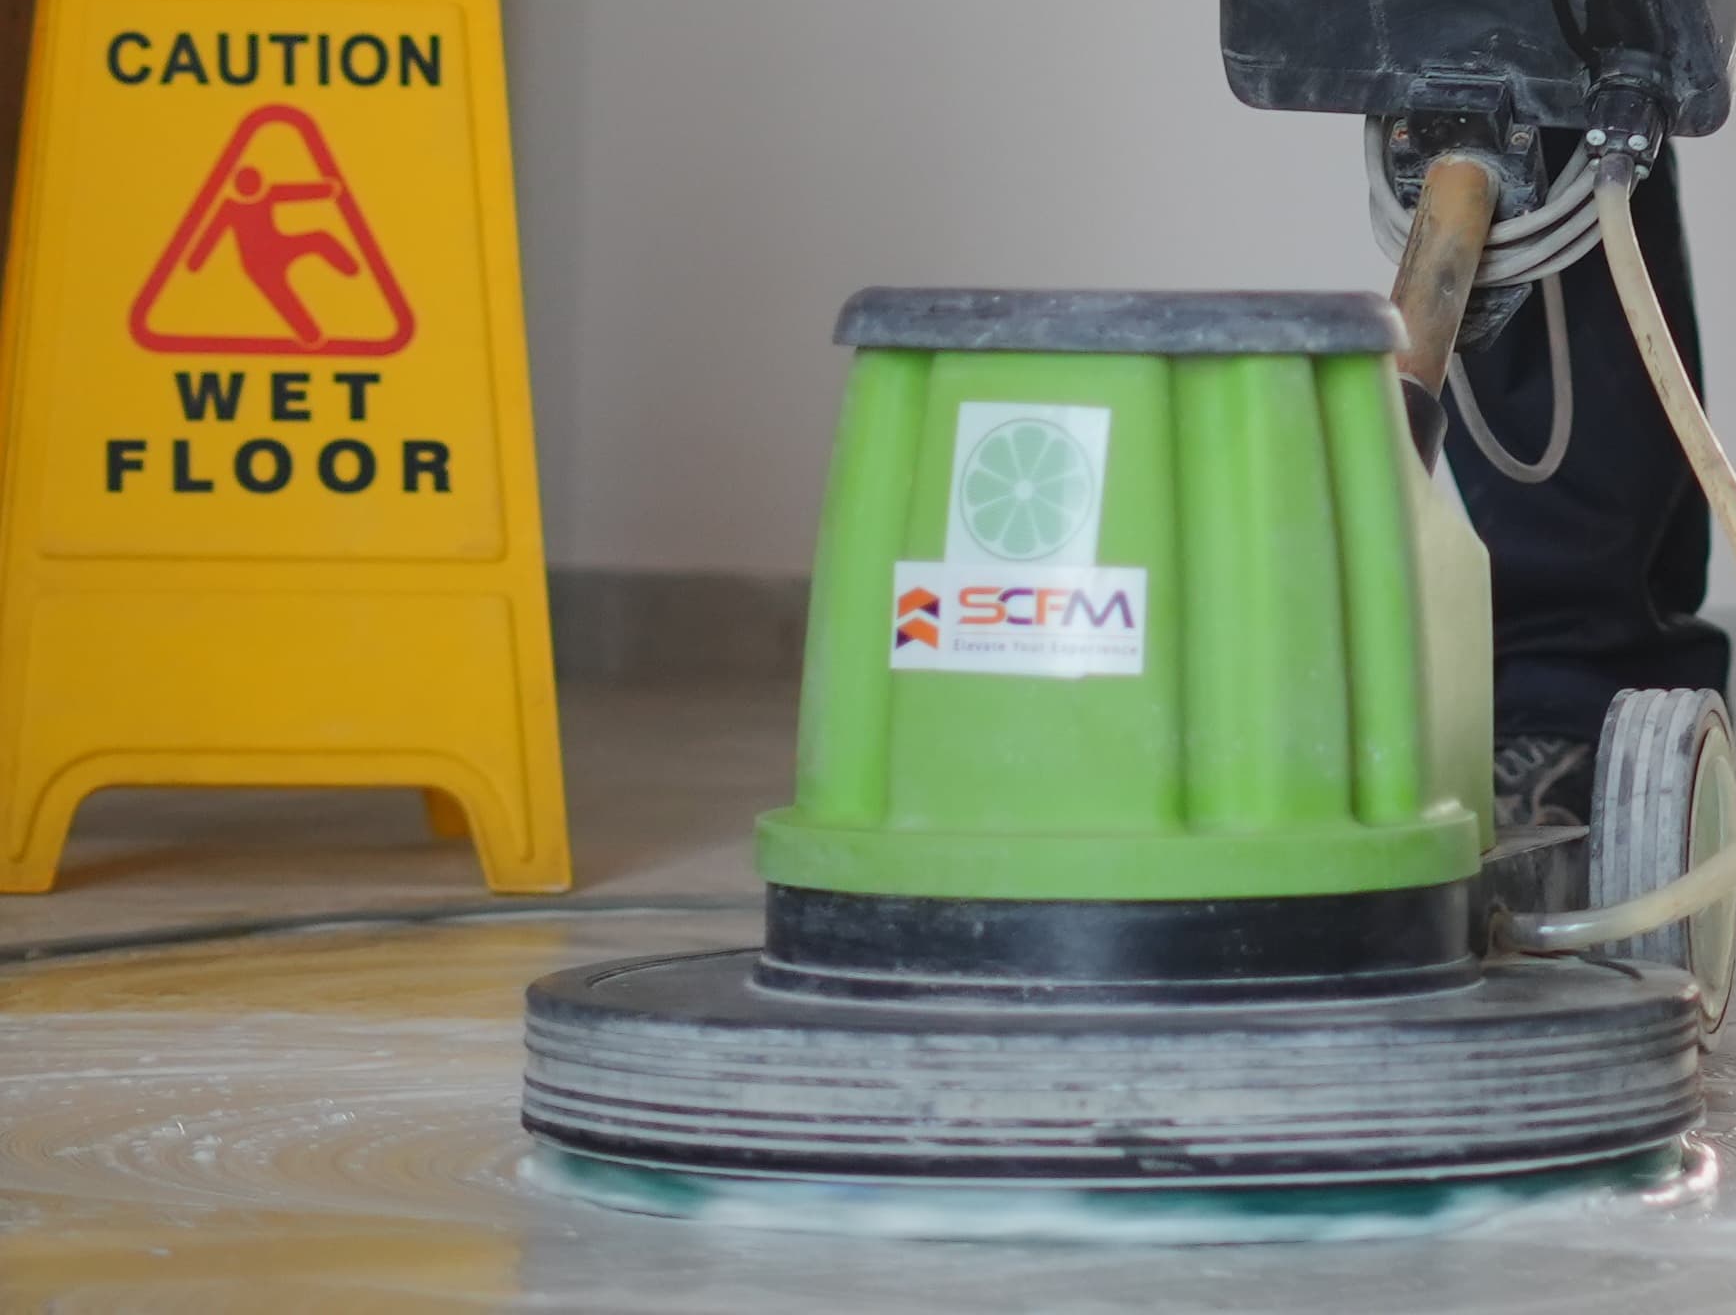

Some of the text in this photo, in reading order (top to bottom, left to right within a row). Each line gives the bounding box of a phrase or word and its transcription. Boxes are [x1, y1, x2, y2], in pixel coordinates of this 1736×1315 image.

[106, 31, 441, 86] CAUTION
[174, 371, 380, 422] WET
[106, 438, 451, 493] FLOOR
[957, 587, 1134, 628] SCFM
